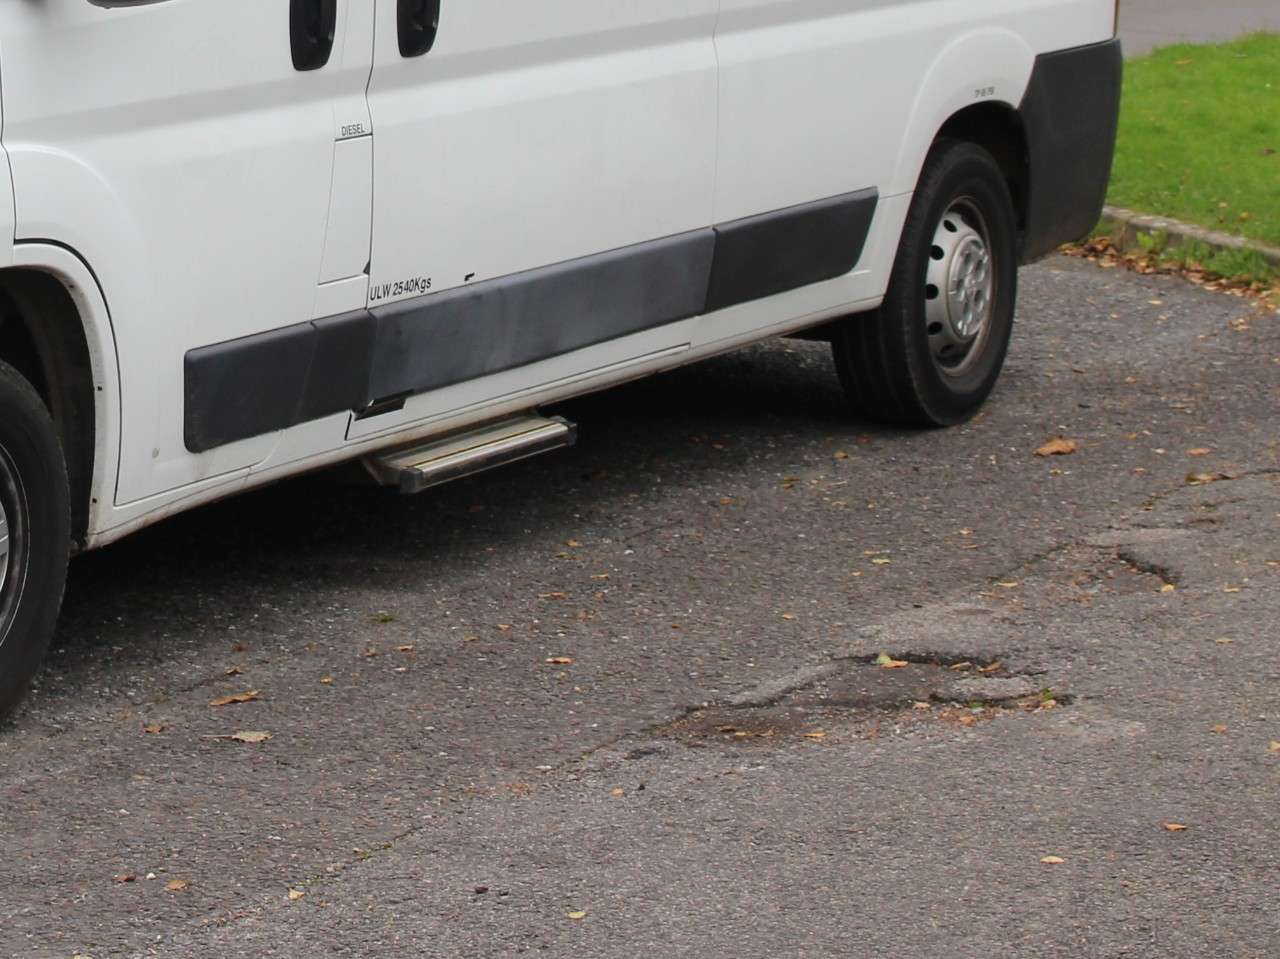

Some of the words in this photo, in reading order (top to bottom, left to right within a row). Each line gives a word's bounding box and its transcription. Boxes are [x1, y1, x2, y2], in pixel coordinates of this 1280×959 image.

[341, 123, 366, 136] DIESEL
[369, 283, 392, 301] ULW
[393, 276, 432, 293] 2540Kgs
